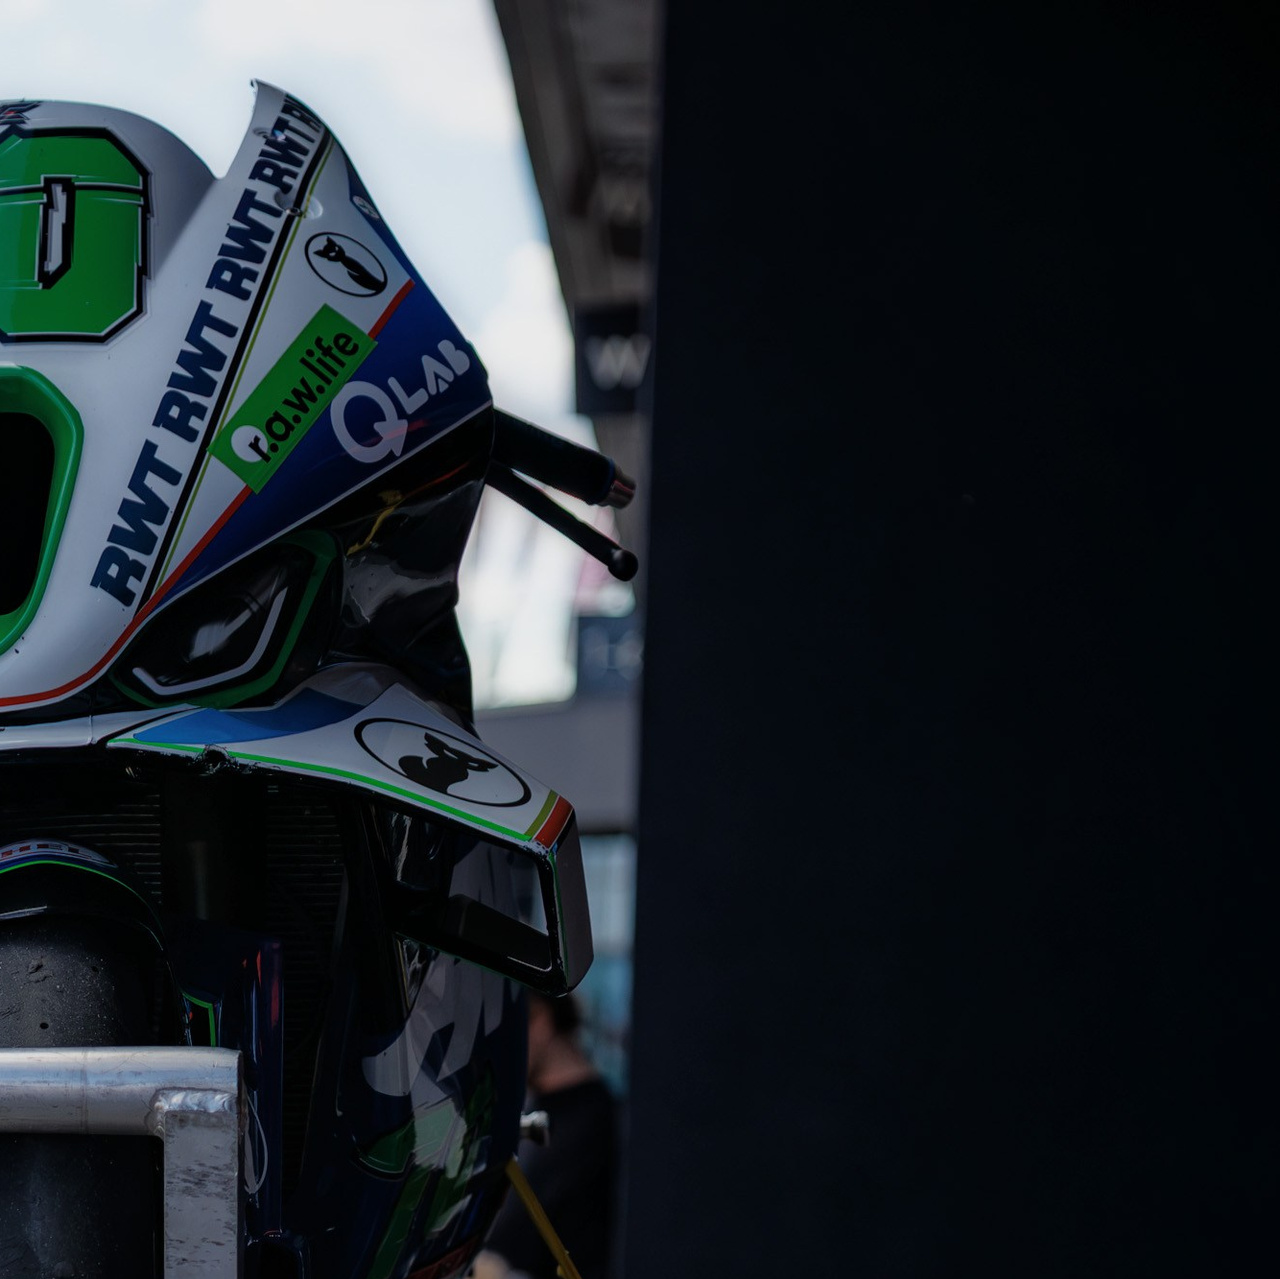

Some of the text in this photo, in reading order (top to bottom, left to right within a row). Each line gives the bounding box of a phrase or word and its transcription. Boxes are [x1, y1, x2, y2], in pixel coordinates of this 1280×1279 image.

[249, 116, 316, 195] RWT
[206, 190, 283, 302] RWT
[153, 300, 239, 443] RWT
[248, 332, 360, 464] r.a.w.life
[90, 439, 183, 608] RWT
